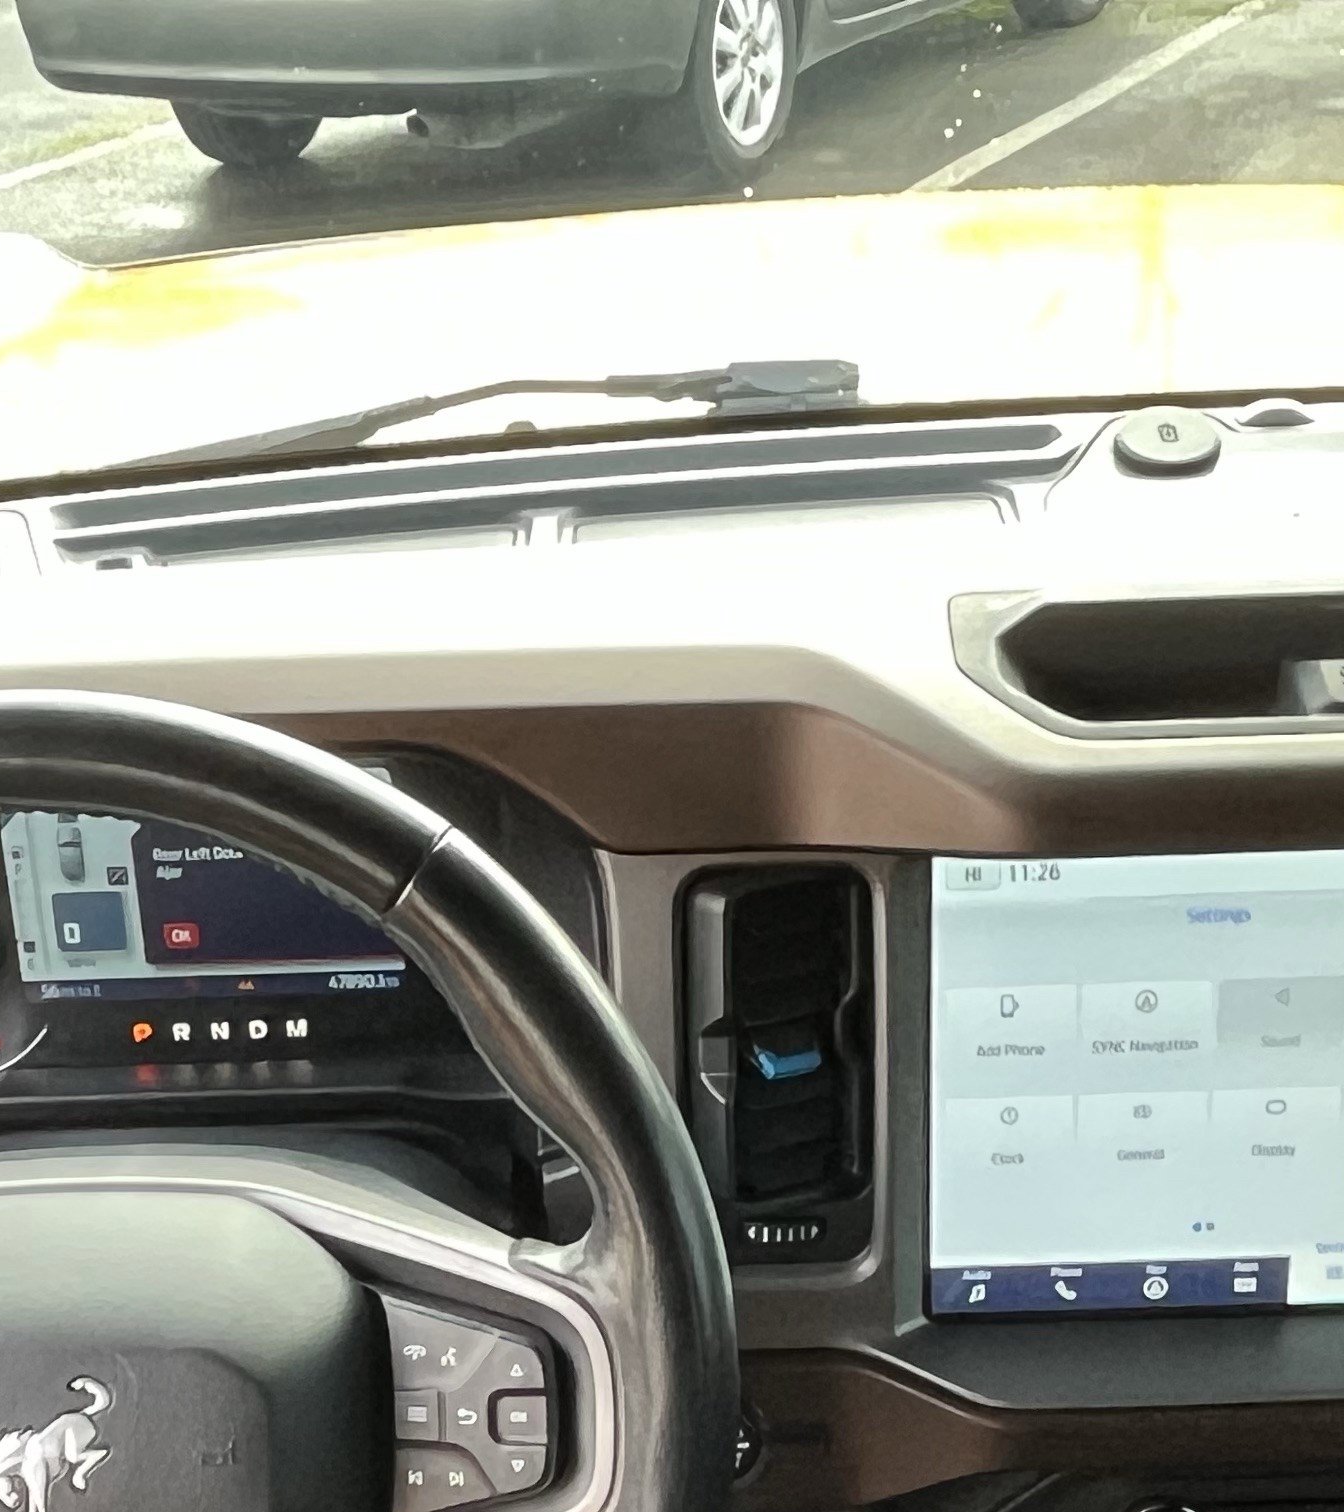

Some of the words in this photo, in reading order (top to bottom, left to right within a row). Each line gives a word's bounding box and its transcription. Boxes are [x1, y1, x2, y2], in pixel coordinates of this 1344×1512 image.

[132, 1022, 153, 1043] P
[172, 1022, 190, 1041] R
[210, 1021, 230, 1040] N
[249, 1019, 268, 1039] D
[286, 1018, 307, 1038] M
